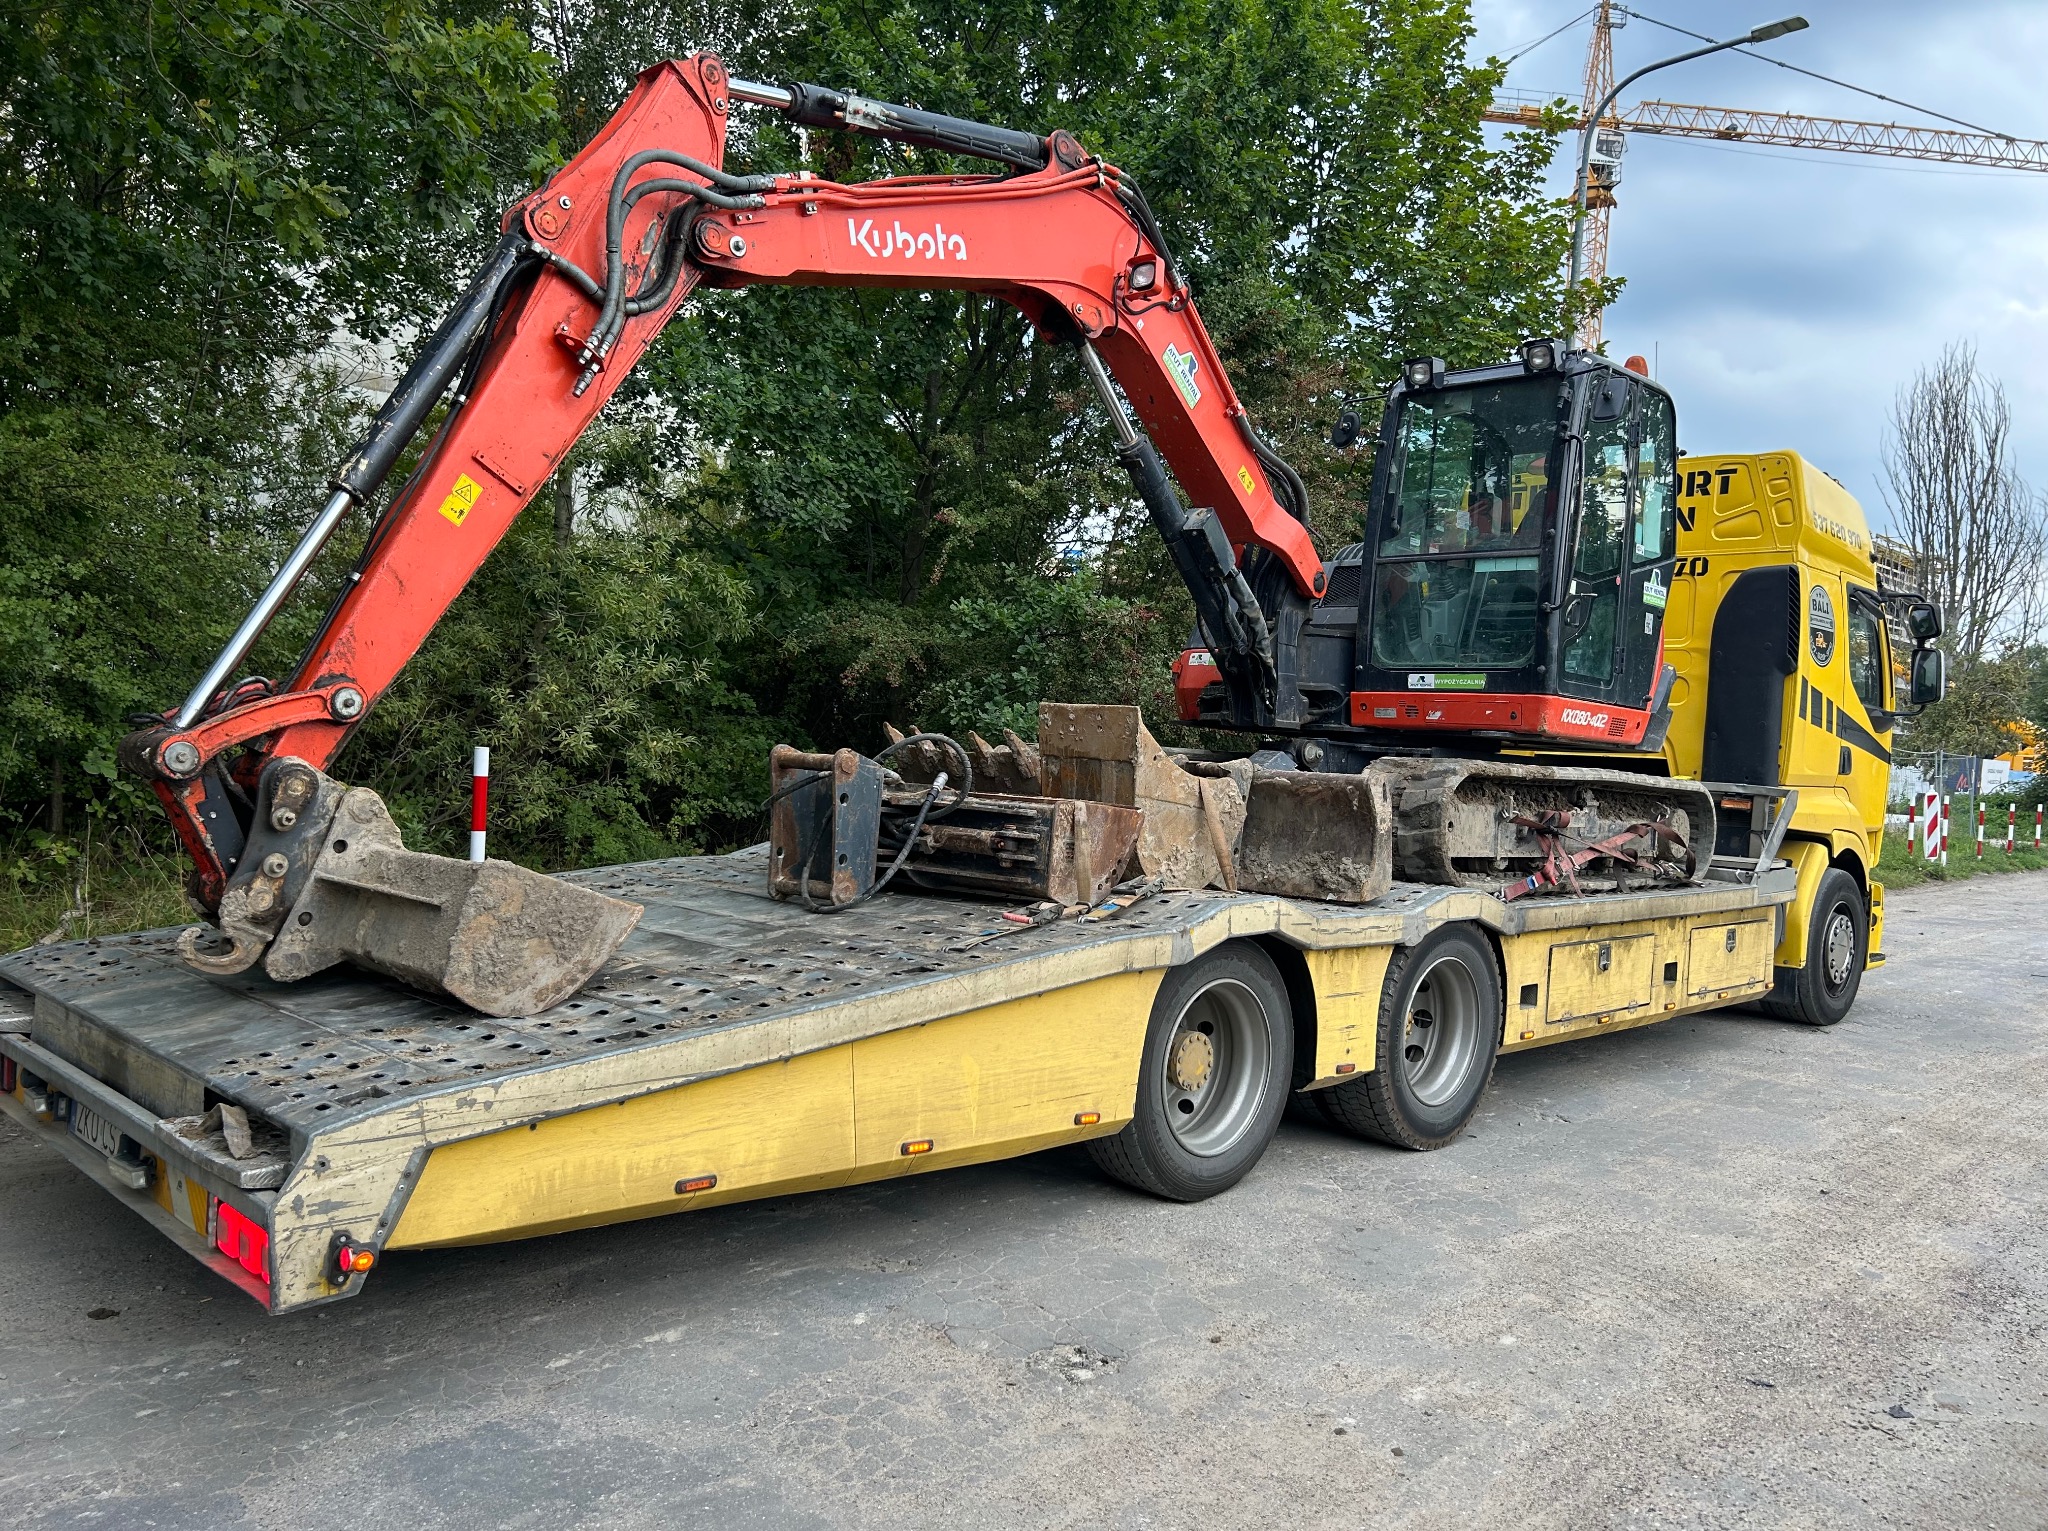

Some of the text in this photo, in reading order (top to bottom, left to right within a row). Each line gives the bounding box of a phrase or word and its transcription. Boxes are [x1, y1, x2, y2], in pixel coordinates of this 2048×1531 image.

[847, 218, 967, 260] Kubota
[1181, 369, 1198, 400] RENTAL
[1677, 468, 1738, 497] RT
[1813, 511, 1828, 534] 537
[1830, 521, 1846, 542] 620
